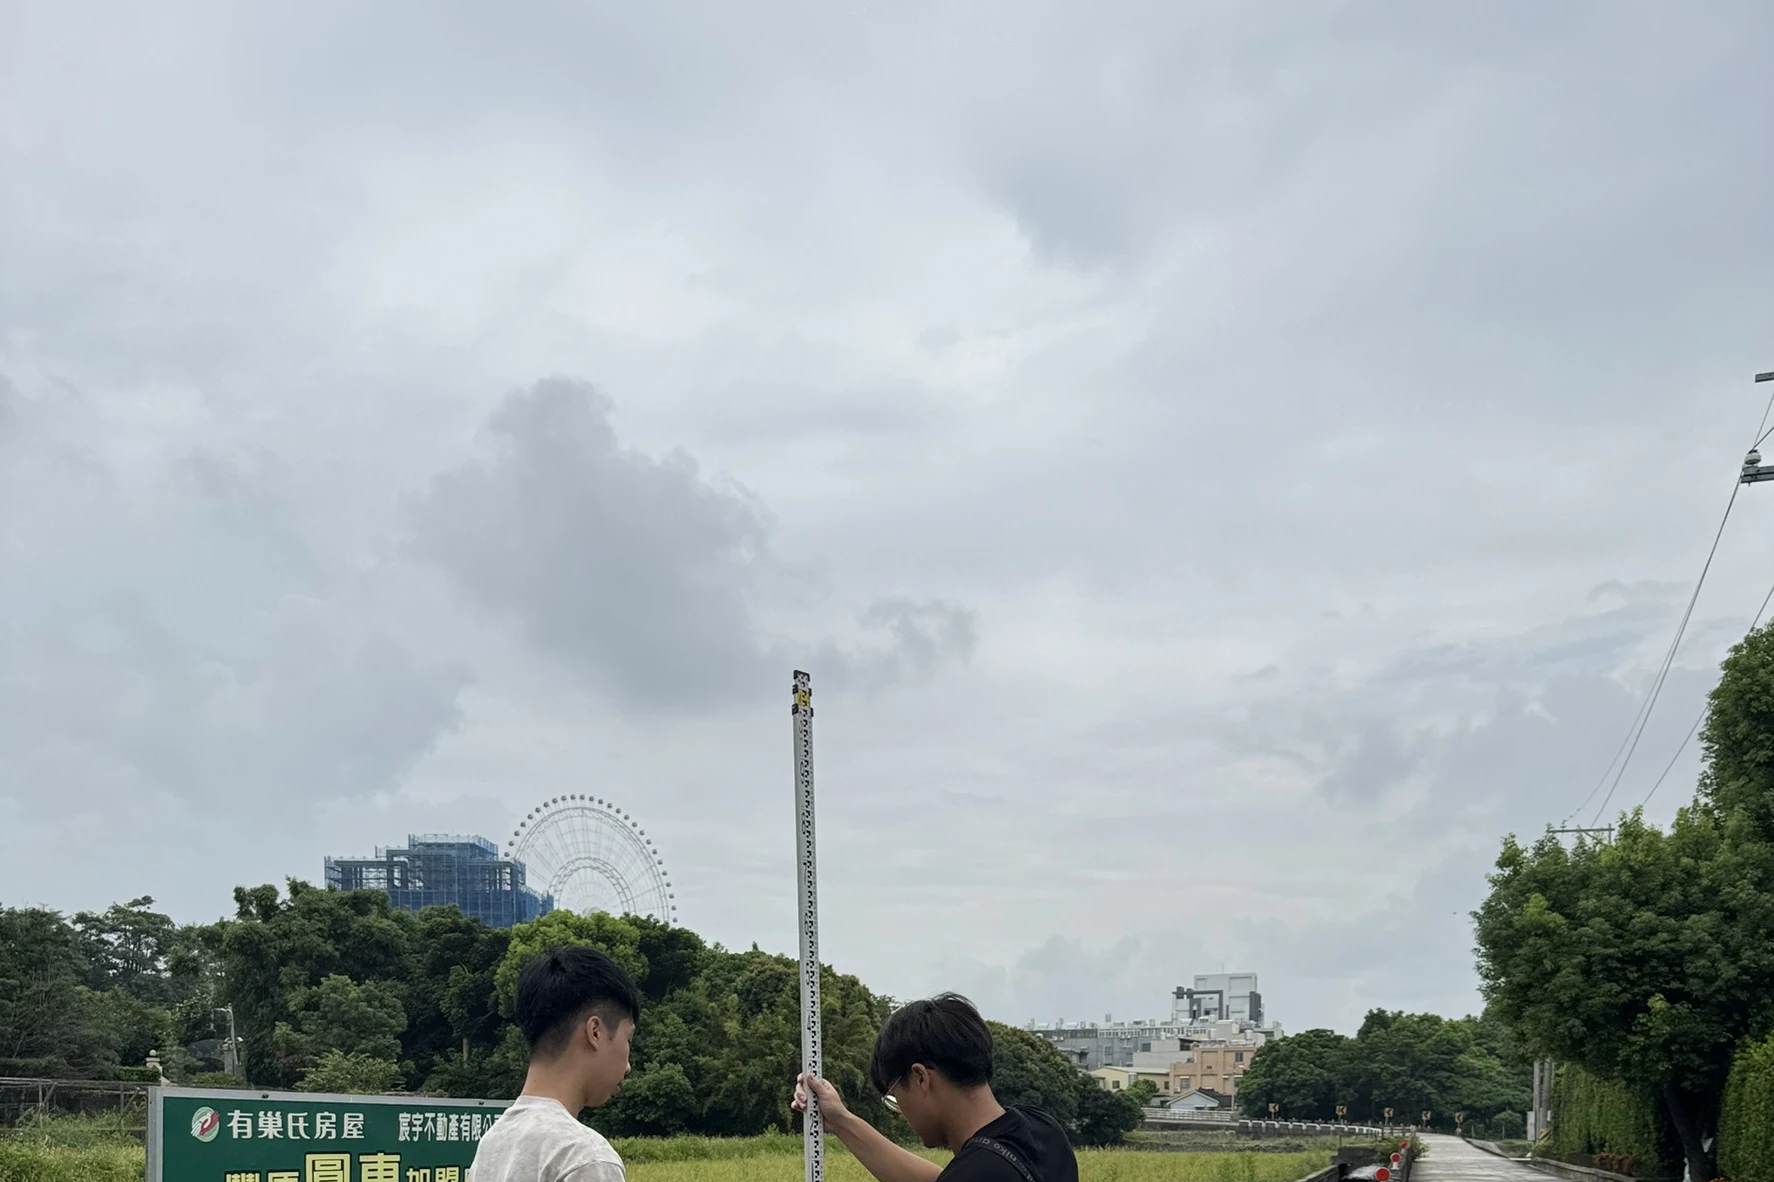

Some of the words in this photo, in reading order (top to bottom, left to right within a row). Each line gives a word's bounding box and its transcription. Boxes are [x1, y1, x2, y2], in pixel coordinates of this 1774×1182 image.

[227, 1109, 365, 1140] 有巢氏房屋
[398, 1112, 501, 1142] 宸宇不動產有限公
